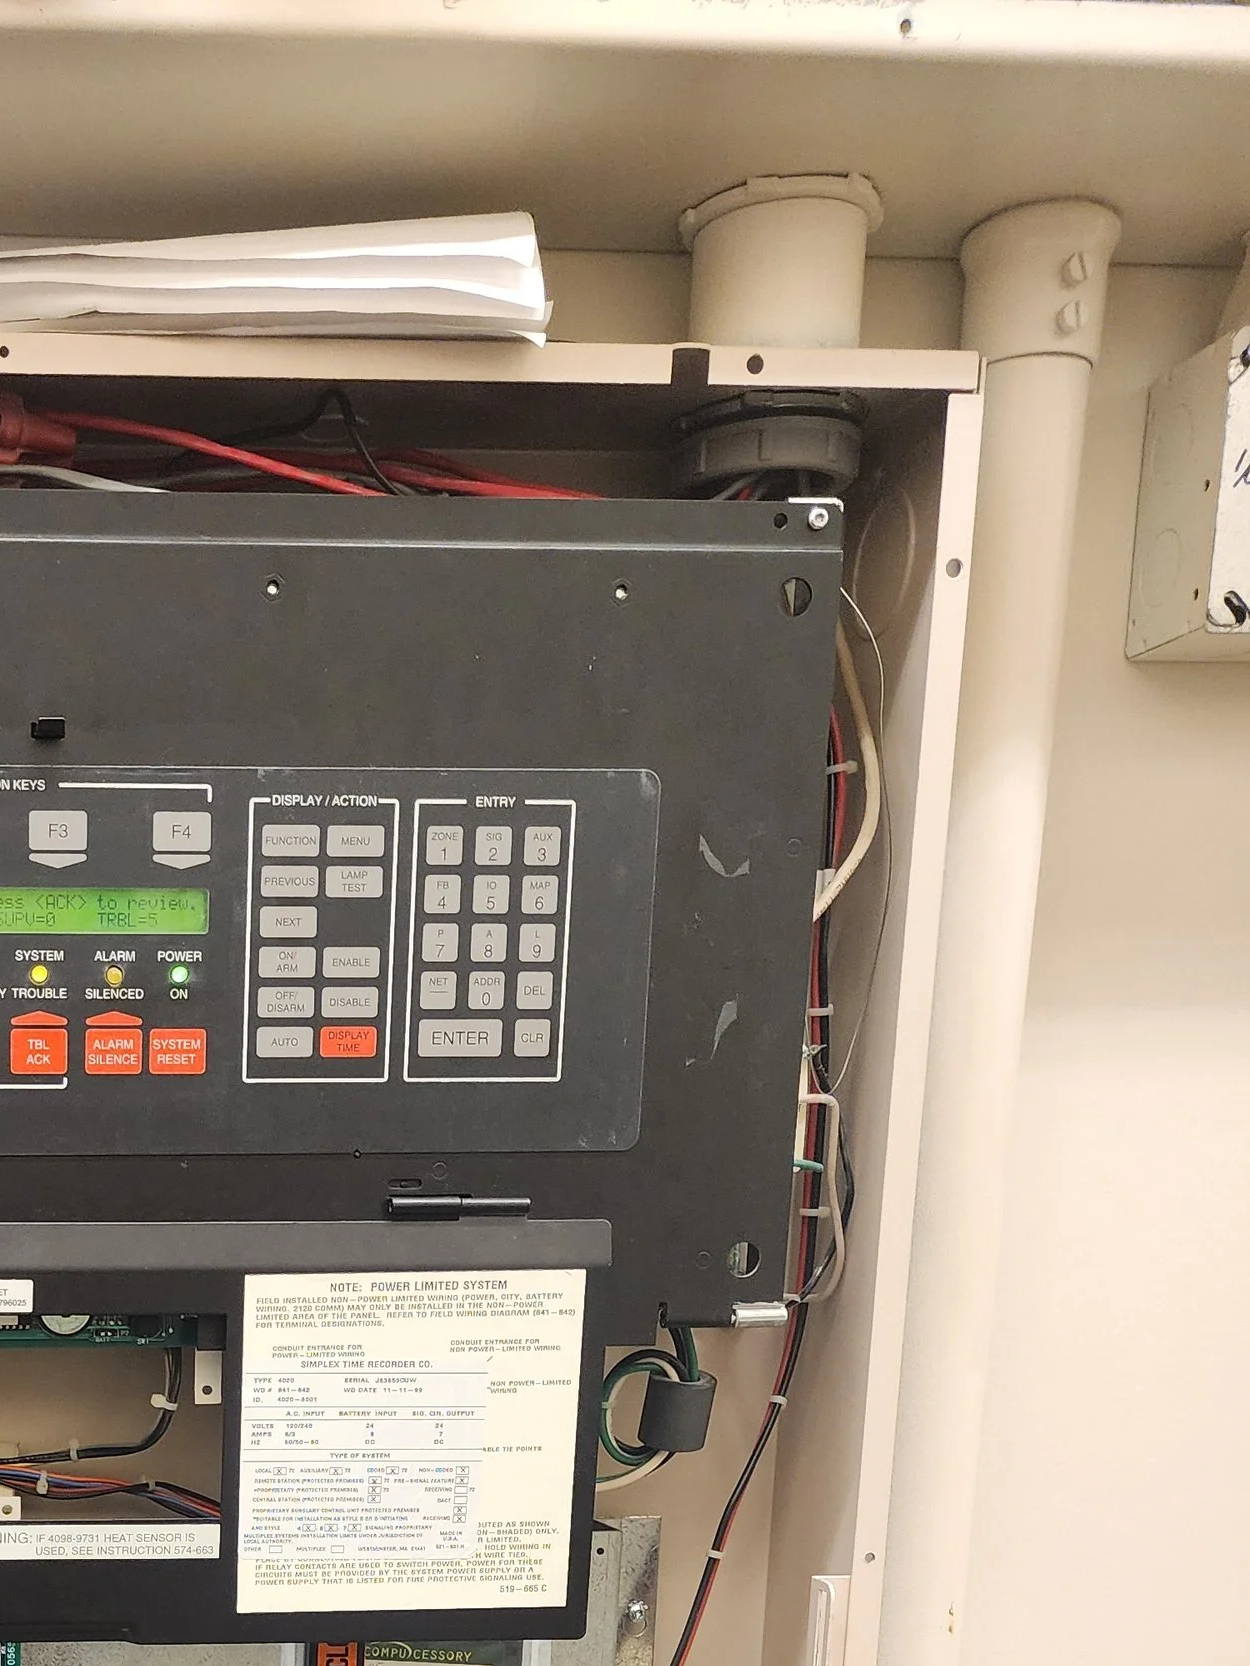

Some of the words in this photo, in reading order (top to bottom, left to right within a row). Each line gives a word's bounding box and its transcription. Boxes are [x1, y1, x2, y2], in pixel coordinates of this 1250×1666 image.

[13, 779, 46, 791] KEYS
[272, 795, 322, 806] DISPLAY
[332, 795, 378, 807] ACTION
[475, 796, 516, 808] ENTRY
[48, 824, 68, 838] F3
[172, 825, 191, 839] F4
[266, 836, 316, 845] FUNCTION
[341, 837, 370, 845] MENU
[431, 833, 458, 841] ZONE
[486, 833, 502, 841] SIG
[533, 833, 553, 841] AUX
[488, 848, 498, 861] 2
[537, 848, 547, 862] 3
[341, 871, 367, 879] LAMP
[264, 877, 315, 886] PREVIOUS
[437, 881, 449, 889] FB
[530, 882, 550, 890] MAP
[342, 884, 367, 892] TEST
[97, 895, 117, 910] to
[437, 896, 446, 909] 4
[486, 897, 495, 910] 5
[534, 896, 544, 910] 6
[275, 918, 302, 926] NEXT
[14, 950, 64, 961] SYSTEM
[279, 951, 297, 960] ON/
[436, 944, 445, 957] 7
[484, 944, 493, 958] 8
[532, 944, 541, 958] 9
[94, 951, 136, 962] ALARM
[157, 951, 202, 962] POWER
[332, 958, 370, 967] ENABLE
[276, 964, 298, 972] ARM
[429, 977, 449, 986] NET
[473, 978, 500, 986] ADDR
[12, 988, 68, 999] TROUBLE
[85, 988, 144, 1000] SILENCED
[170, 989, 188, 999] ON
[523, 986, 545, 995] DEL
[329, 998, 370, 1006] DISABLE
[482, 992, 490, 1005] 0
[267, 1004, 305, 1012] DISARM
[328, 1032, 370, 1040] DISPLAY
[432, 1031, 489, 1045] ENTER
[521, 1033, 544, 1043] CLR
[27, 1039, 49, 1049] TBL
[93, 1039, 134, 1049] ALARM
[152, 1039, 200, 1050] SYSTEM
[271, 1038, 298, 1046] AUTO
[337, 1044, 359, 1052] TIME
[26, 1054, 50, 1064] ACK
[88, 1054, 138, 1065] SILENCE
[157, 1054, 196, 1064] RESET
[330, 1283, 362, 1292] NOTE:
[371, 1282, 410, 1292] POWER
[415, 1281, 459, 1291] LIMITED
[463, 1280, 507, 1290] SYSTEM
[367, 1360, 416, 1368] RECORDER
[36, 1534, 46, 1543] IF
[48, 1534, 99, 1543] 4098-9731
[104, 1533, 133, 1542] HEAT
[135, 1533, 182, 1542] SENSOR
[185, 1533, 196, 1542] IS
[35, 1546, 68, 1557] USED,
[71, 1546, 94, 1556] SEE
[97, 1546, 171, 1555] INSTRUCTION
[174, 1545, 214, 1555] 574-663
